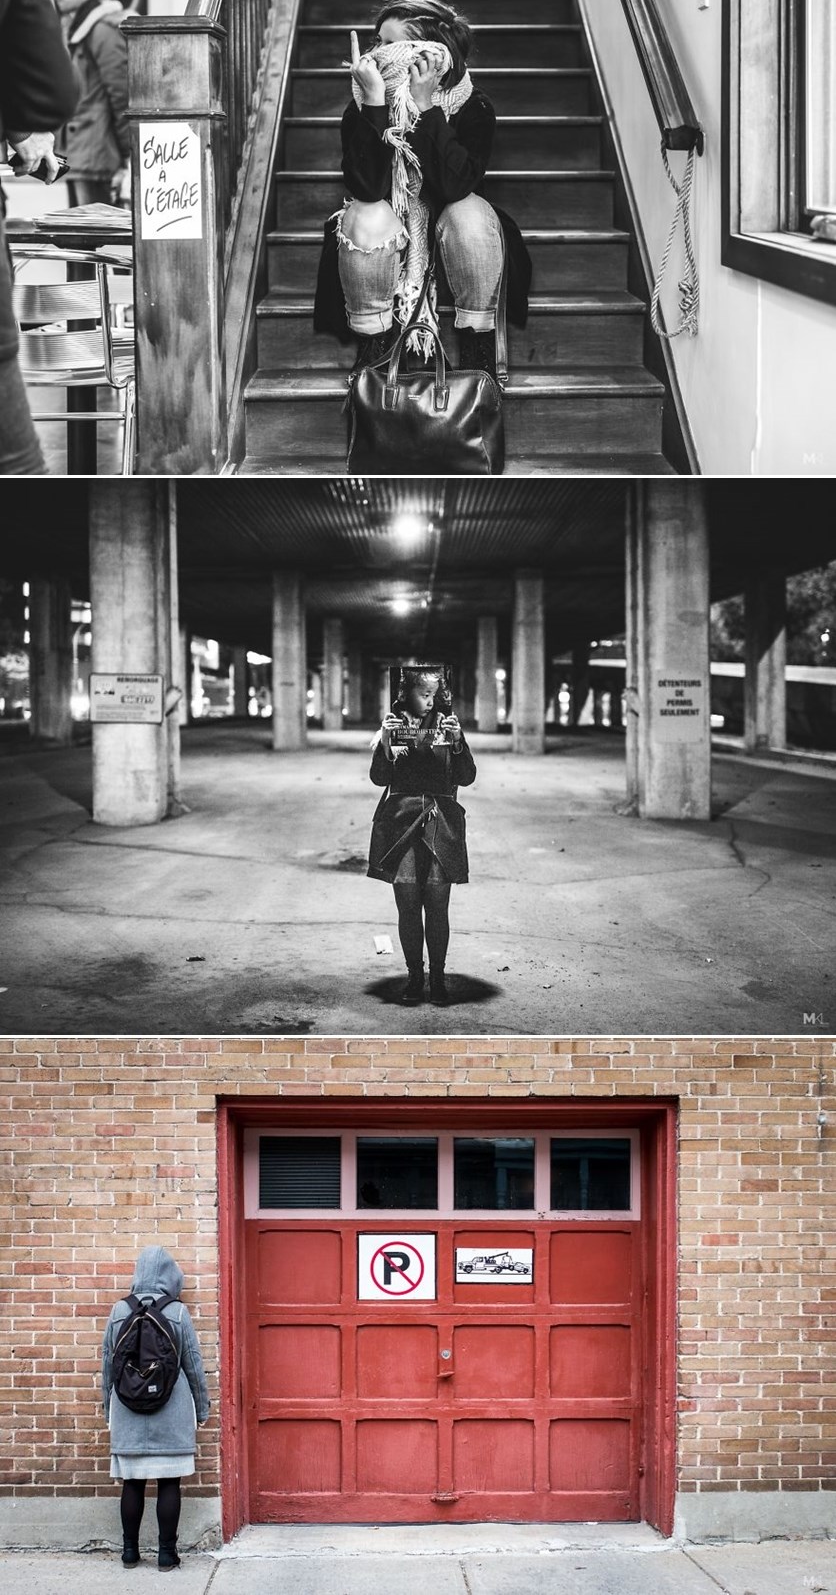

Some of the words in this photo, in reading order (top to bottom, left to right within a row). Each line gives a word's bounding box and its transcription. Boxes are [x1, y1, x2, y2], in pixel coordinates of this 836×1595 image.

[143, 135, 189, 170] SALLE
[658, 678, 702, 688] DÉTENTEURS
[675, 689, 684, 697] DE
[660, 708, 699, 716] SEULEMENT
